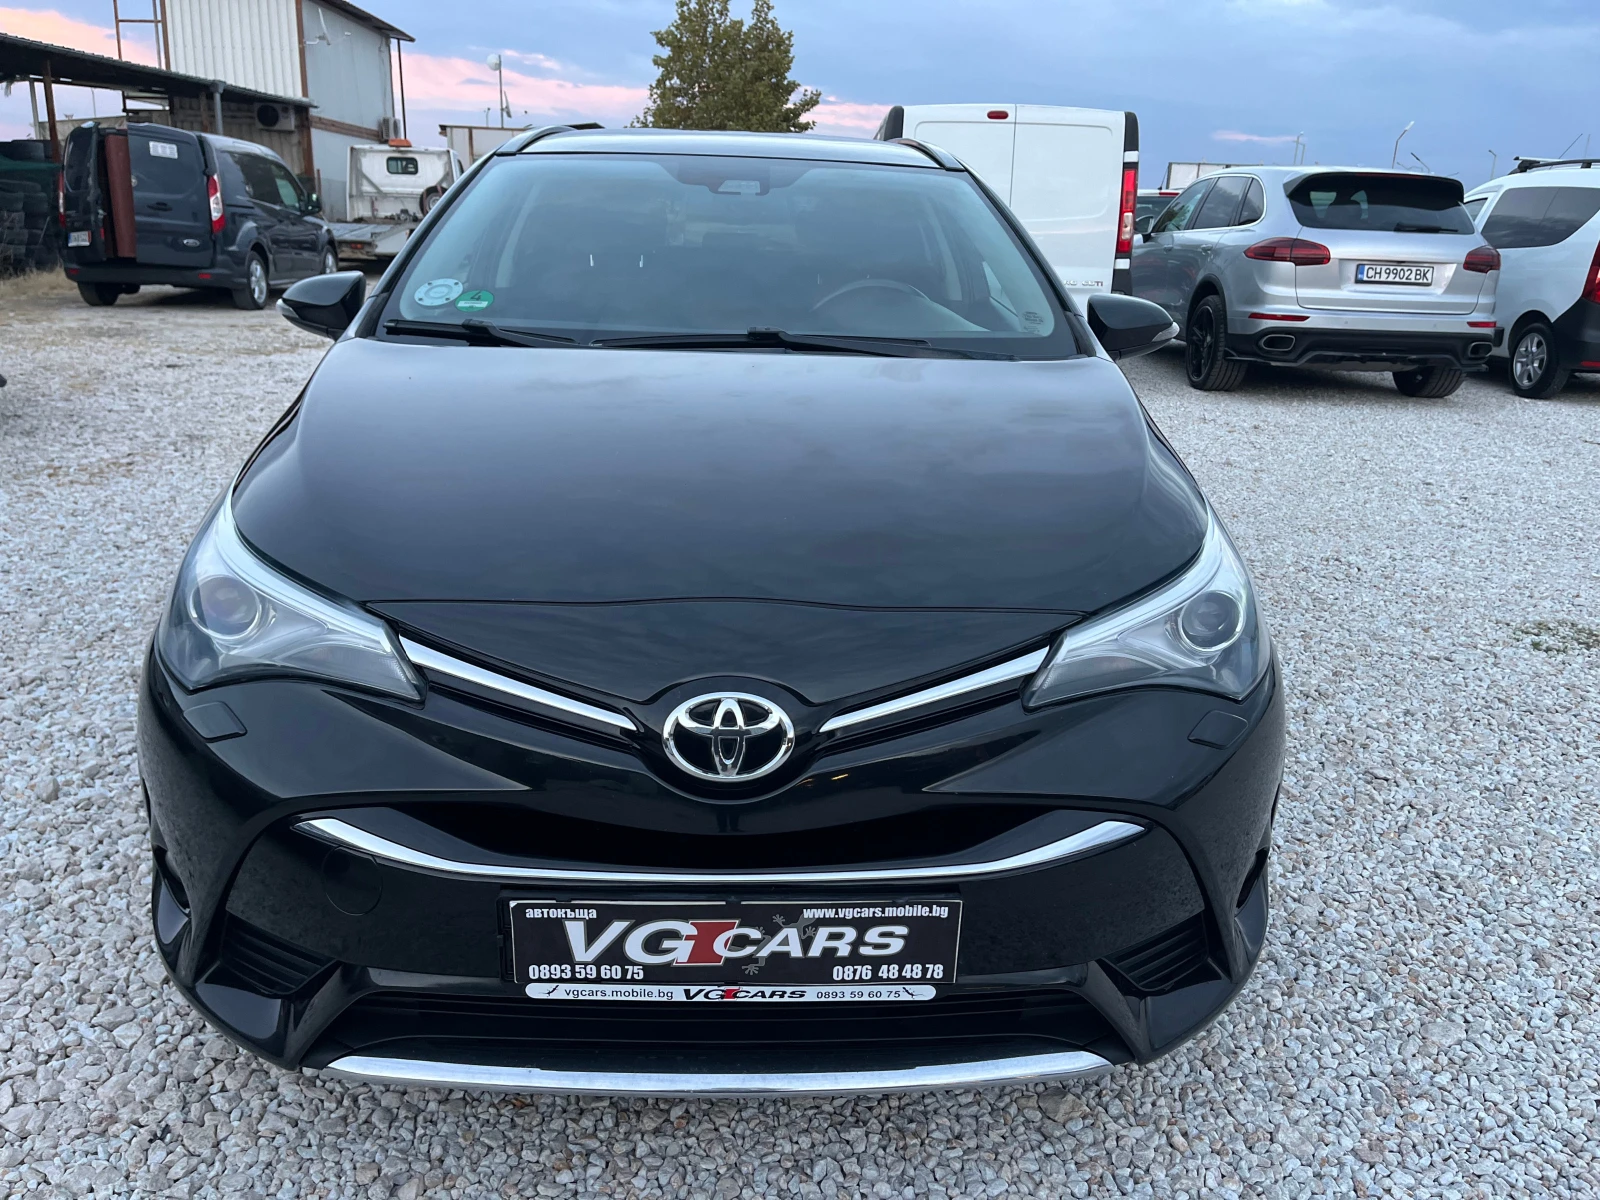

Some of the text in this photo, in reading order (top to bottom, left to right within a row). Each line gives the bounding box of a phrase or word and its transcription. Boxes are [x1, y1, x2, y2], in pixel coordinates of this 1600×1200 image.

[1366, 267, 1430, 281] CH 9902 BK
[525, 908, 597, 920] автокъща
[803, 905, 949, 919] www.vgcars.mobile.bg
[528, 964, 644, 980] 0893 59 60 75
[832, 964, 944, 981] 0876 48 48 78
[564, 987, 674, 1000] vgcars.mobile.bg
[816, 990, 845, 999] 0893
[849, 990, 864, 999] 59
[867, 990, 882, 999] 60
[886, 990, 901, 999] 75
